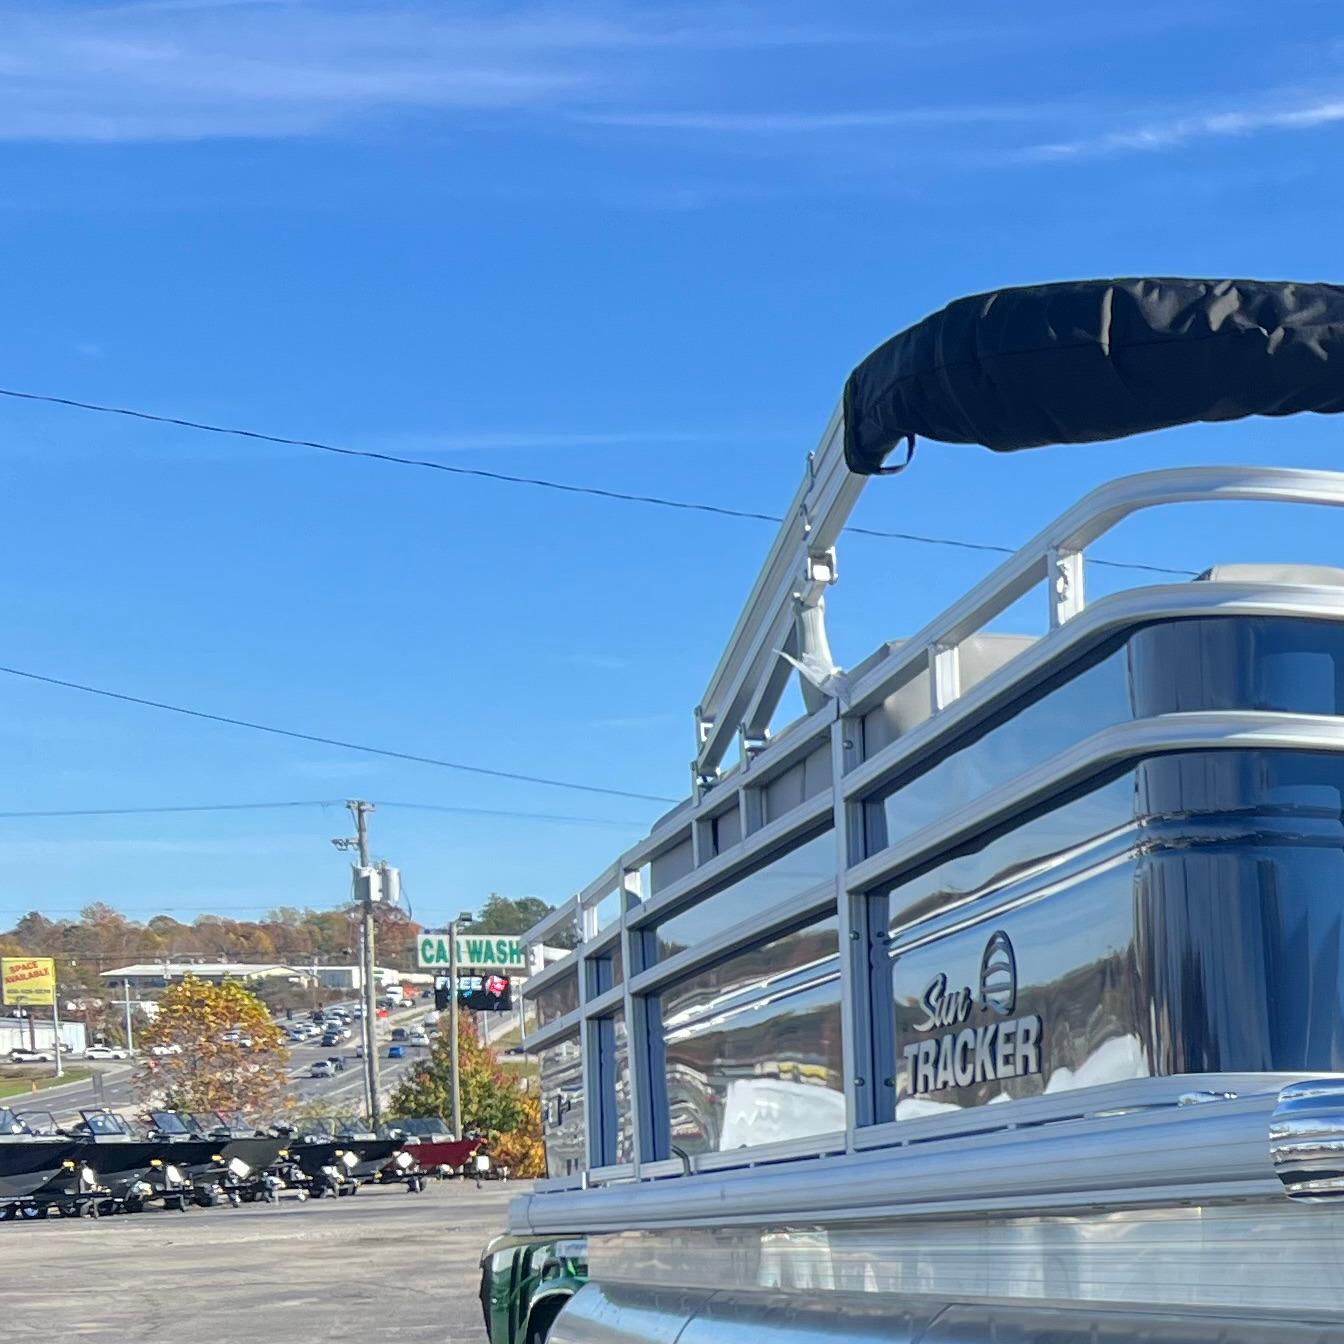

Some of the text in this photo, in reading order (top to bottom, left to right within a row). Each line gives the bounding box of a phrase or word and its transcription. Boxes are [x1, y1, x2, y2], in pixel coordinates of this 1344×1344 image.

[9, 961, 38, 973] SPACE
[466, 938, 521, 964] WASH
[912, 973, 973, 1031] Sun
[904, 1015, 1043, 1095] TRACKER
